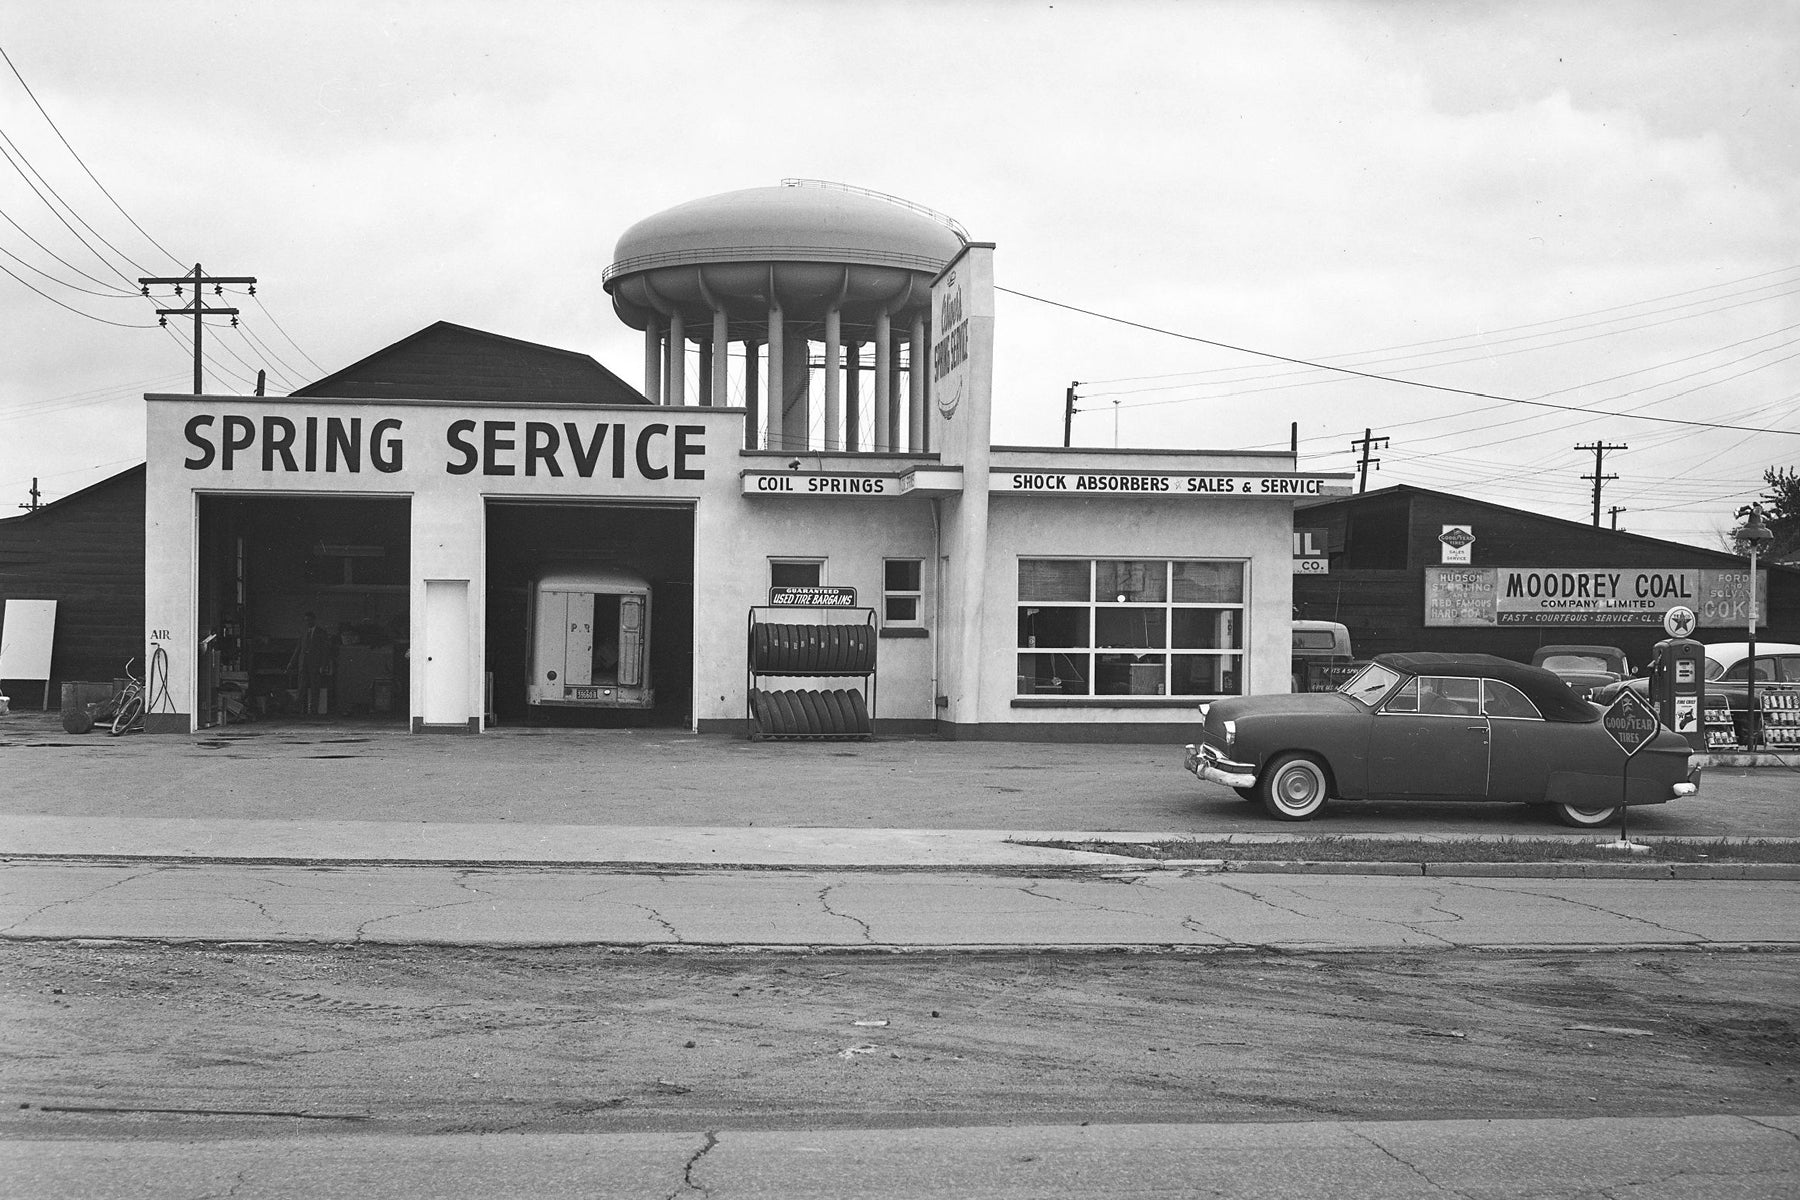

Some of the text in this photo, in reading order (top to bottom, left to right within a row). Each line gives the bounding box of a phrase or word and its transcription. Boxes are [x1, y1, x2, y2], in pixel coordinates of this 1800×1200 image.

[183, 414, 707, 480] SPRING SERVICE
[758, 477, 793, 491] COIL
[809, 478, 884, 493] SPRINGS
[1012, 474, 1067, 490] SHOCK
[1076, 475, 1170, 492] ABSORBERS
[1187, 477, 1234, 493] SALES
[1242, 481, 1252, 493] &
[1301, 561, 1324, 570] CO.
[1440, 574, 1483, 582] HUDSON
[1718, 574, 1749, 583] FORD
[1506, 573, 1692, 598] MOODREY COAL
[773, 593, 853, 605] USED TIRE BARGAINS
[1431, 598, 1492, 607] RED FAMOUS
[1540, 600, 1656, 608] COMPANY LIMITED
[1431, 608, 1489, 618] HARD COAL
[1501, 614, 1527, 622] FAST
[1535, 614, 1588, 622] COURTEOUS
[1595, 614, 1634, 622] SERVICE
[150, 629, 171, 641] AIR
[1618, 731, 1640, 743] TIRES
